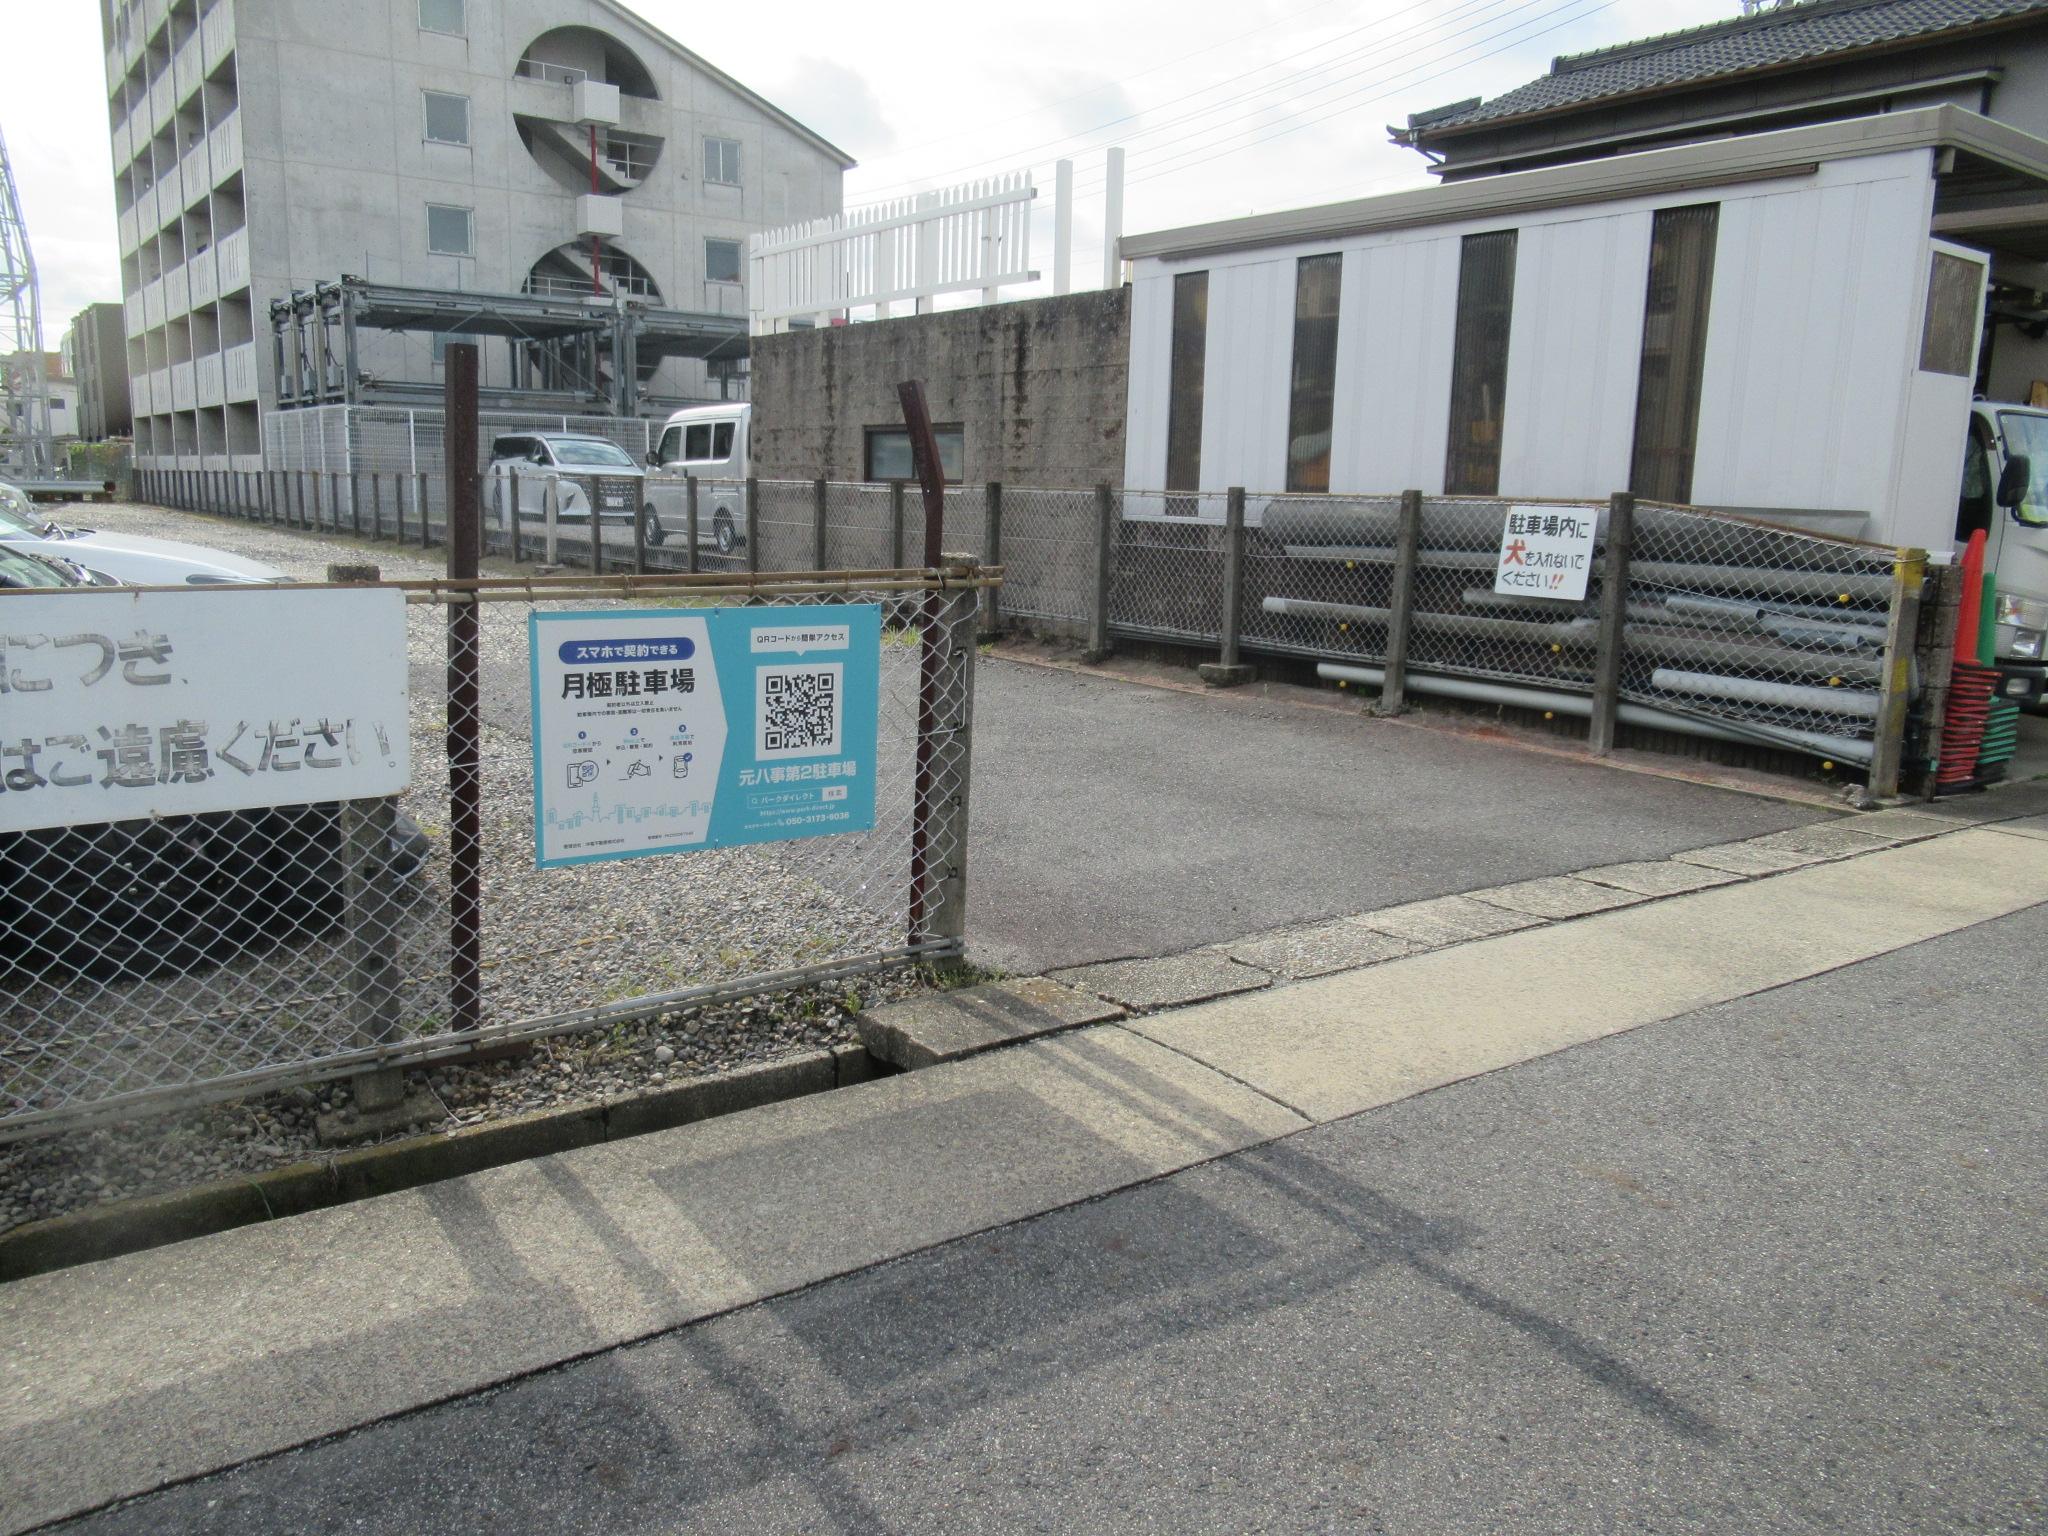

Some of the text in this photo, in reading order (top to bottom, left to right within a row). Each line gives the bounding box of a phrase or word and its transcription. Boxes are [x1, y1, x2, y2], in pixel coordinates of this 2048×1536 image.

[1509, 513, 1590, 539] 駐車場内に
[1503, 539, 1584, 570] 犬を入れないで
[576, 644, 678, 659] スマホで契約できる
[756, 633, 845, 644] QRコードから簡単アクセス
[561, 668, 696, 699] 月極駐車場
[738, 760, 857, 786] 元八事第2駐車場
[761, 792, 815, 805] パークダイレクト
